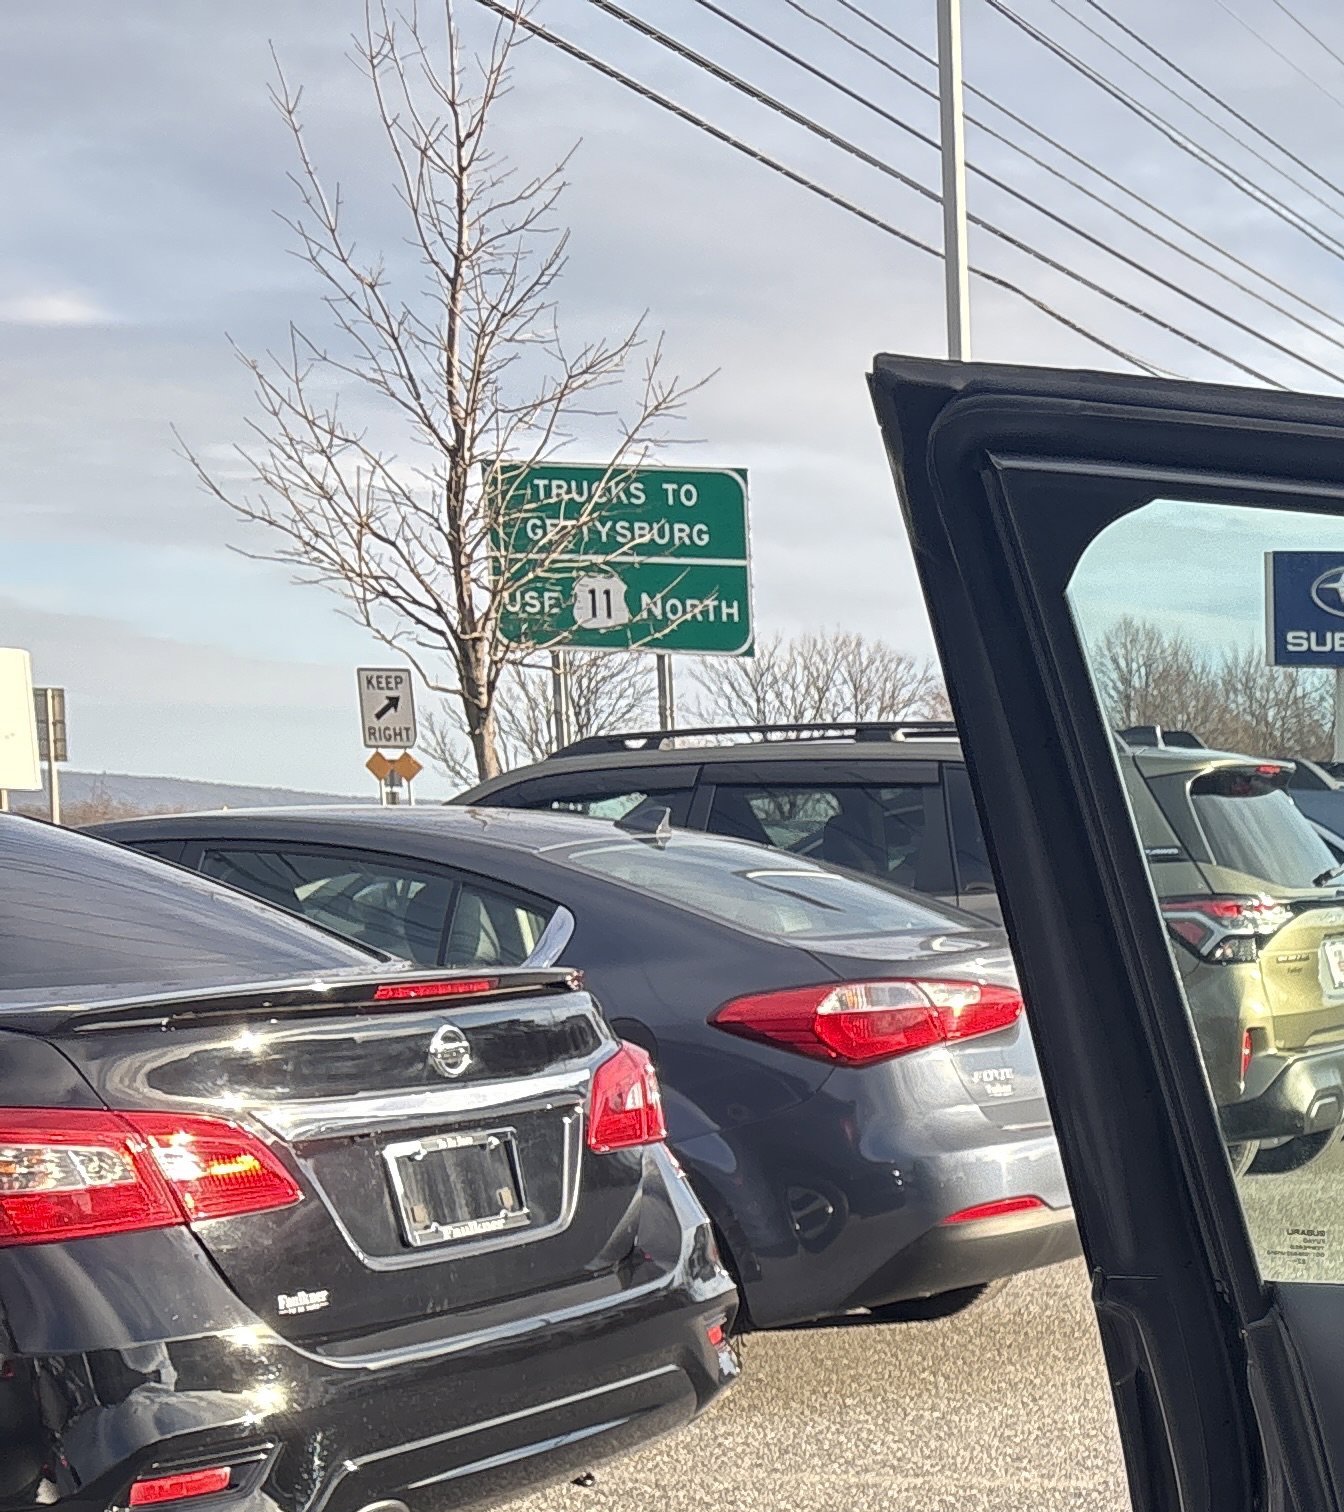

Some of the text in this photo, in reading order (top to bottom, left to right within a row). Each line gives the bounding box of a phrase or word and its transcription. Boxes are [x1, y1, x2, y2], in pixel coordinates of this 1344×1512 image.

[533, 478, 698, 507] TRUCKS TO
[587, 588, 613, 619] 11
[640, 592, 740, 623] NORTH
[365, 674, 404, 691] KEEP
[367, 725, 412, 742] RIGHT
